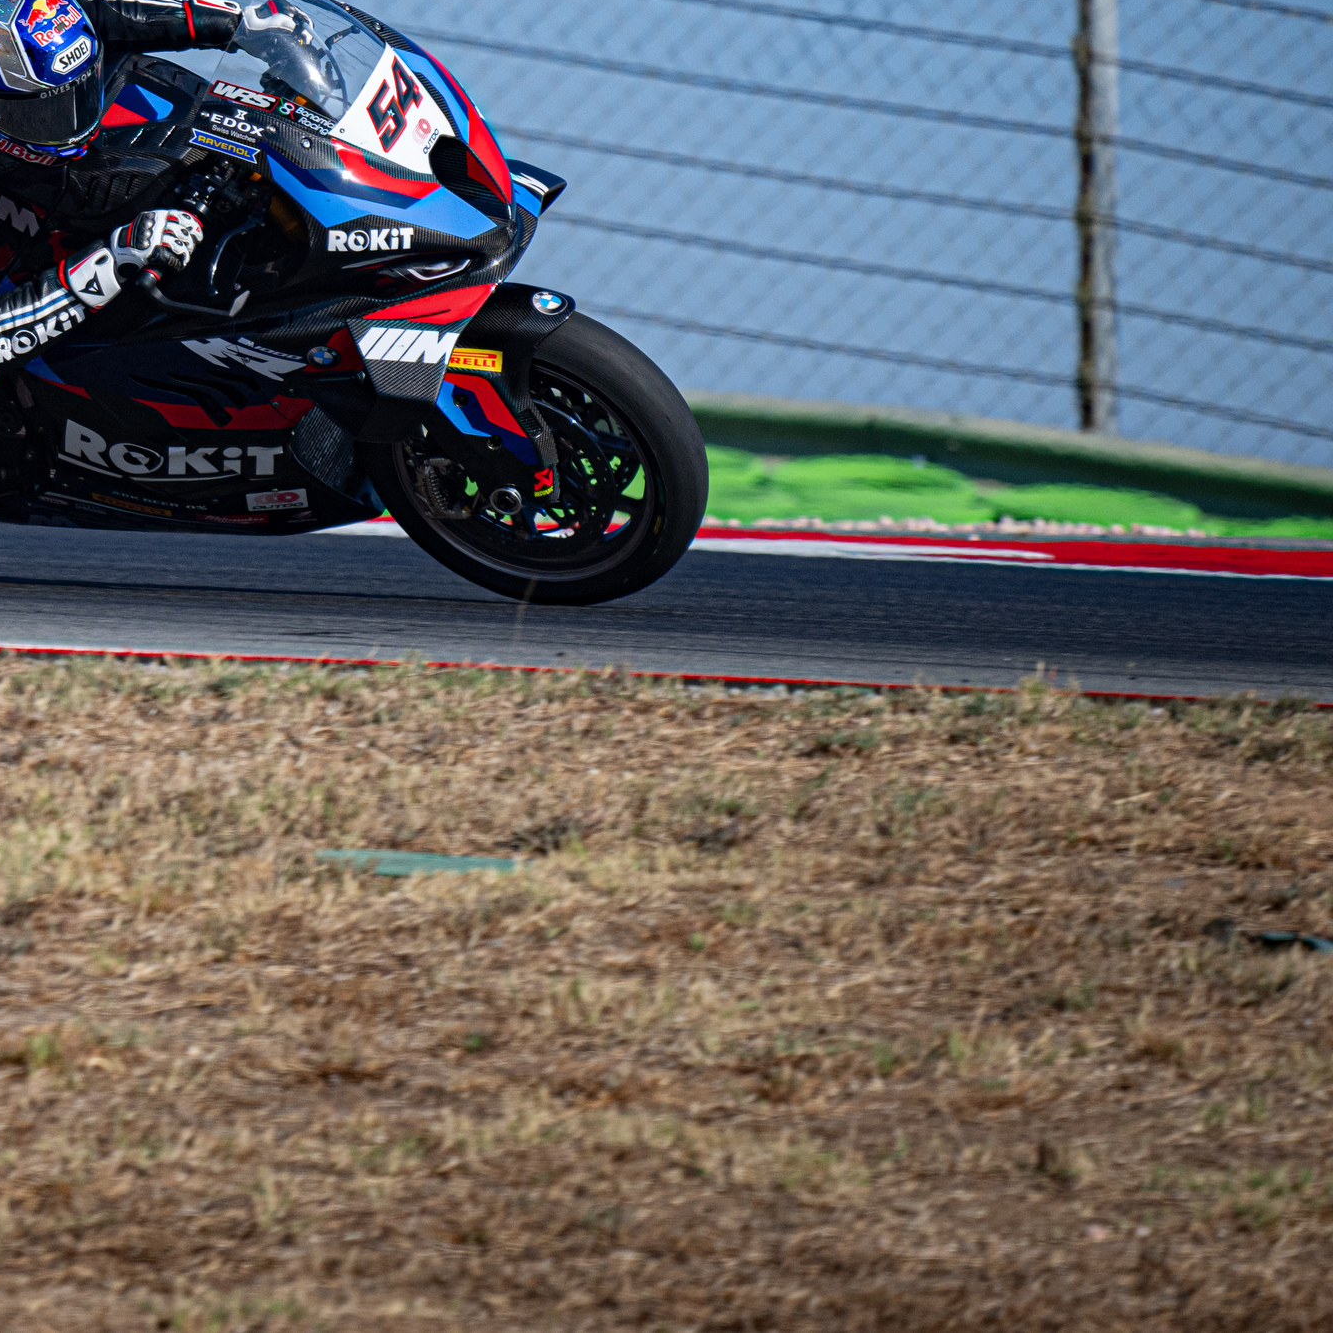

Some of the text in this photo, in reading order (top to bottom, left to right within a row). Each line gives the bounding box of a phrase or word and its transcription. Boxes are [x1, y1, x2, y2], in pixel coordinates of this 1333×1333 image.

[60, 41, 88, 70] SHOEI
[40, 84, 70, 99] GIVES
[213, 81, 276, 109] WRS
[366, 56, 423, 153] 54
[209, 113, 264, 137] EDOX
[211, 124, 256, 143] Swiss Watches
[298, 118, 330, 136] Racing
[197, 135, 251, 158] RAVENOL
[423, 128, 440, 155] OUTDO
[252, 502, 303, 510] OUTDO
